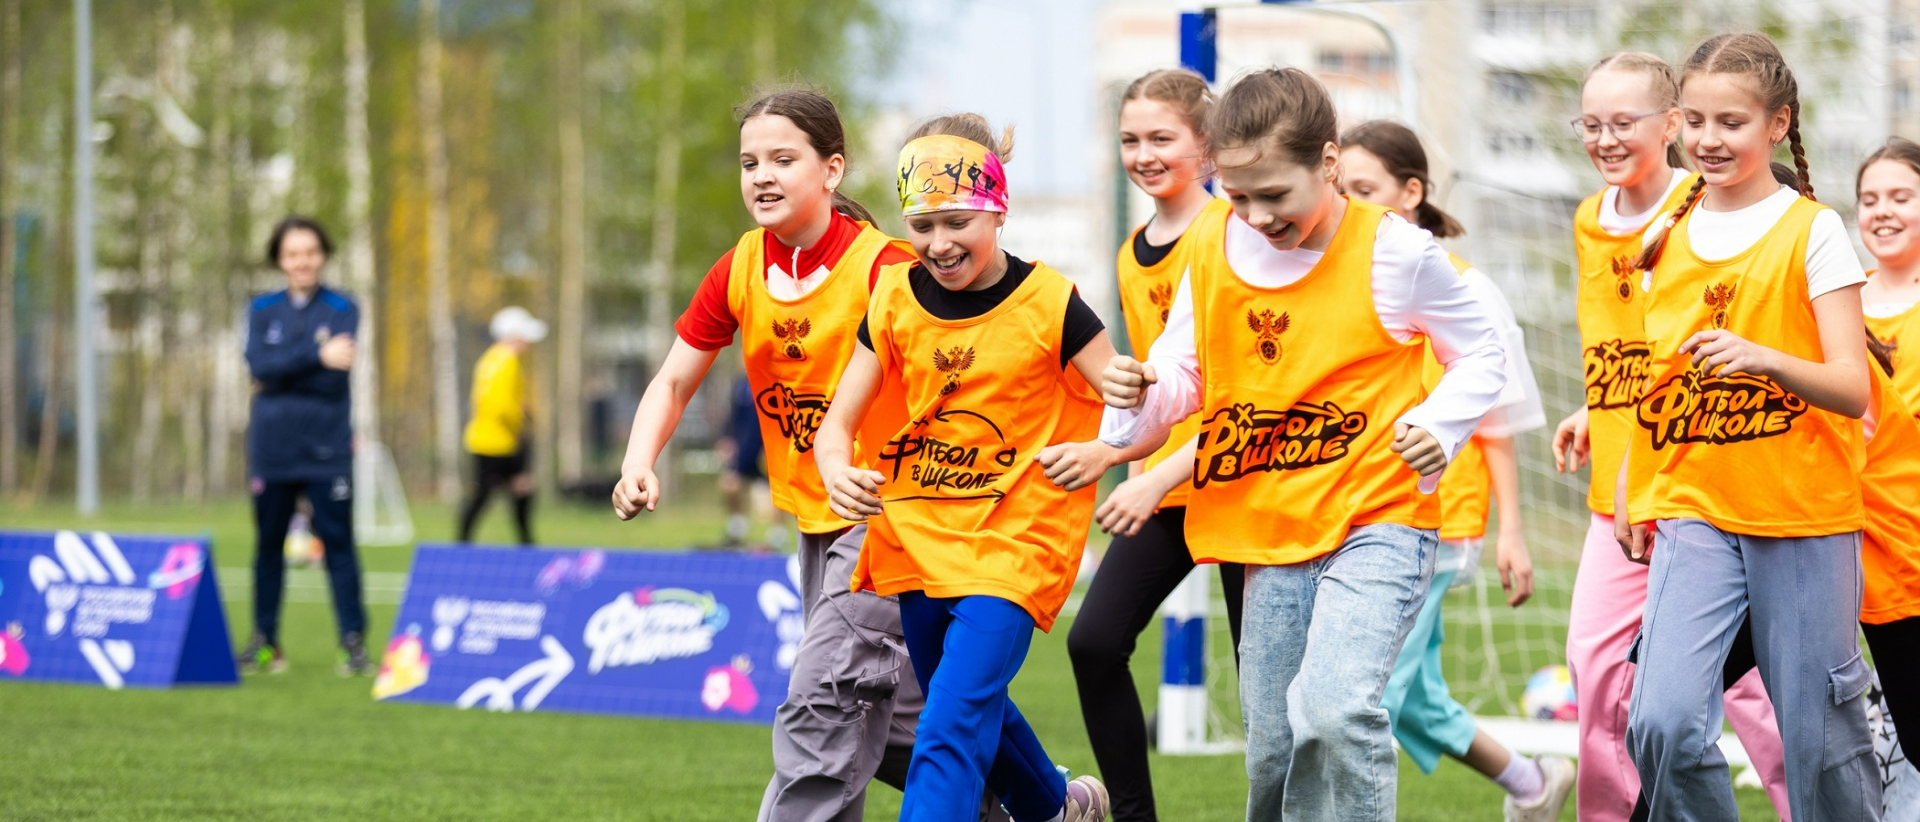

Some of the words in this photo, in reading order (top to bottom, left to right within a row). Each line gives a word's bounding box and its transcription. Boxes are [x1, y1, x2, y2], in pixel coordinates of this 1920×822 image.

[1585, 348, 1651, 391] УТБО
[1640, 378, 1767, 444] ФУТБОЛ
[1673, 419, 1686, 439] В
[1687, 409, 1791, 440] ШКОЛЕ
[879, 433, 979, 484] ФУТБОЛ
[1216, 455, 1237, 476] В
[1240, 435, 1349, 474] ШКОЛЕ
[911, 464, 921, 482] В
[920, 462, 1004, 492] ШКОЛЕ
